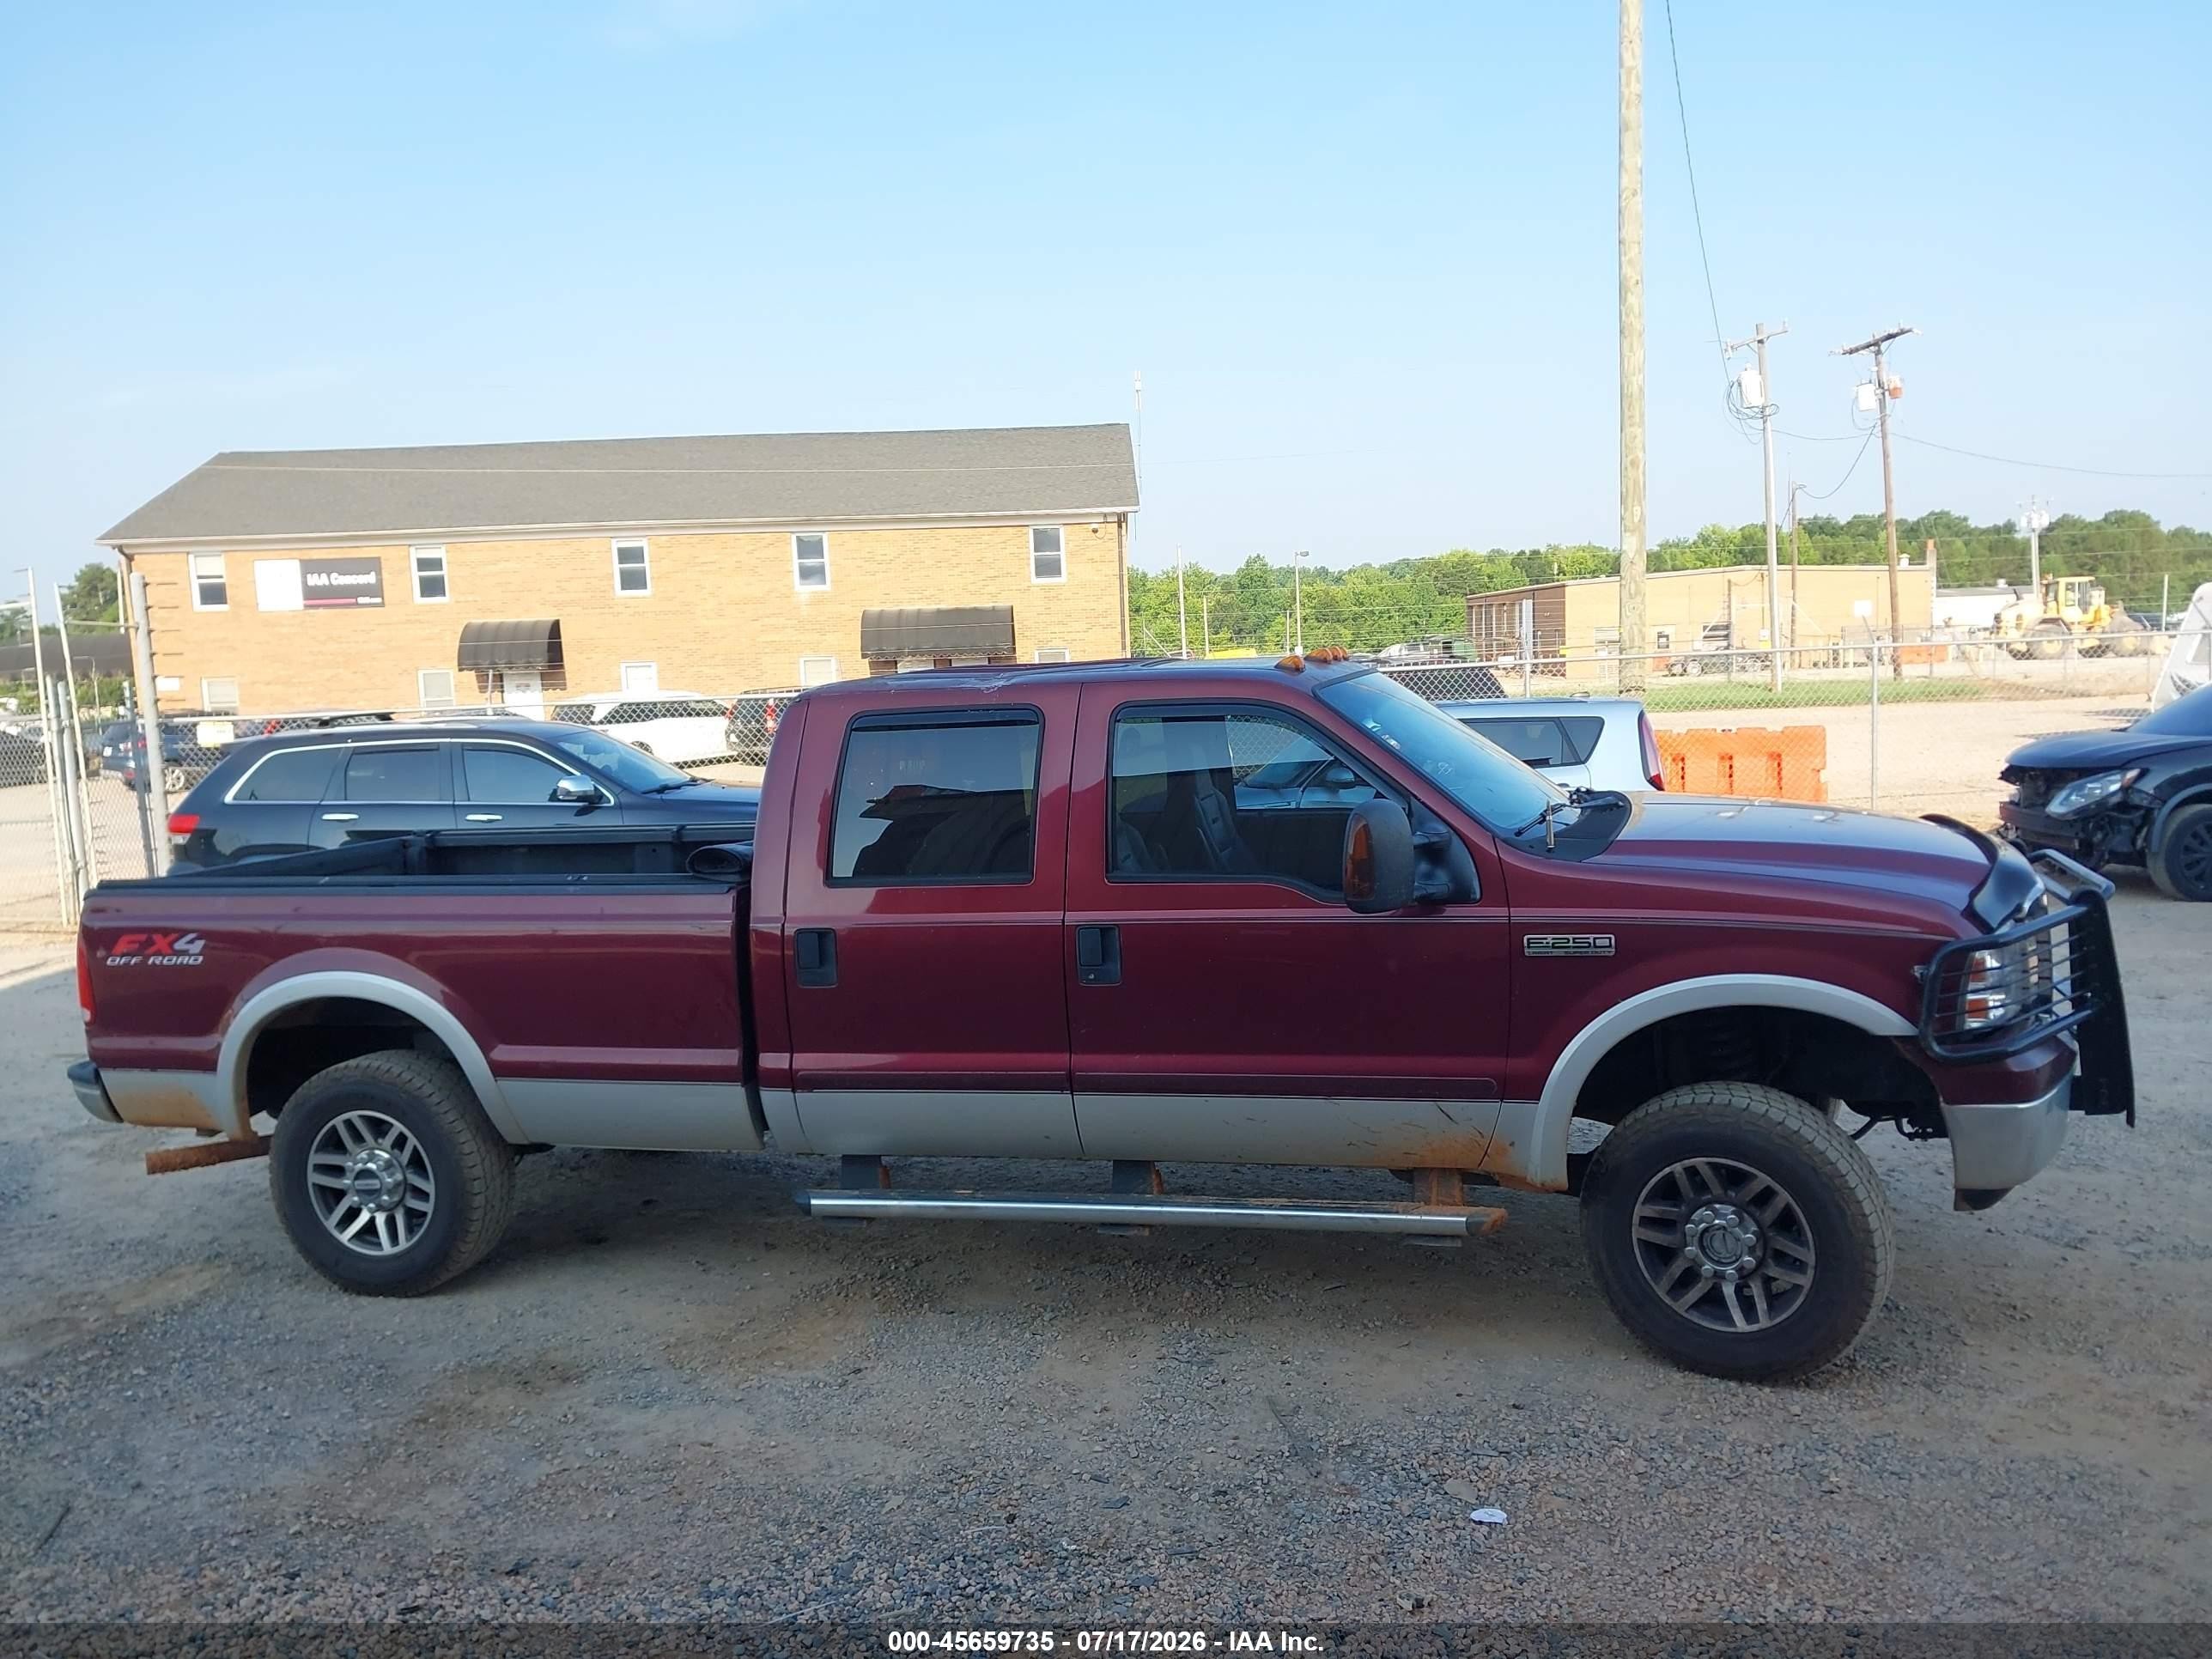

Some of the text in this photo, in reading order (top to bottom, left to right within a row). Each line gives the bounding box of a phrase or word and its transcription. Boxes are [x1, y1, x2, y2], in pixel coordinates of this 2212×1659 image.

[307, 573, 329, 586] IAA
[112, 933, 206, 955] FX4
[106, 955, 204, 966] OFF ROAD
